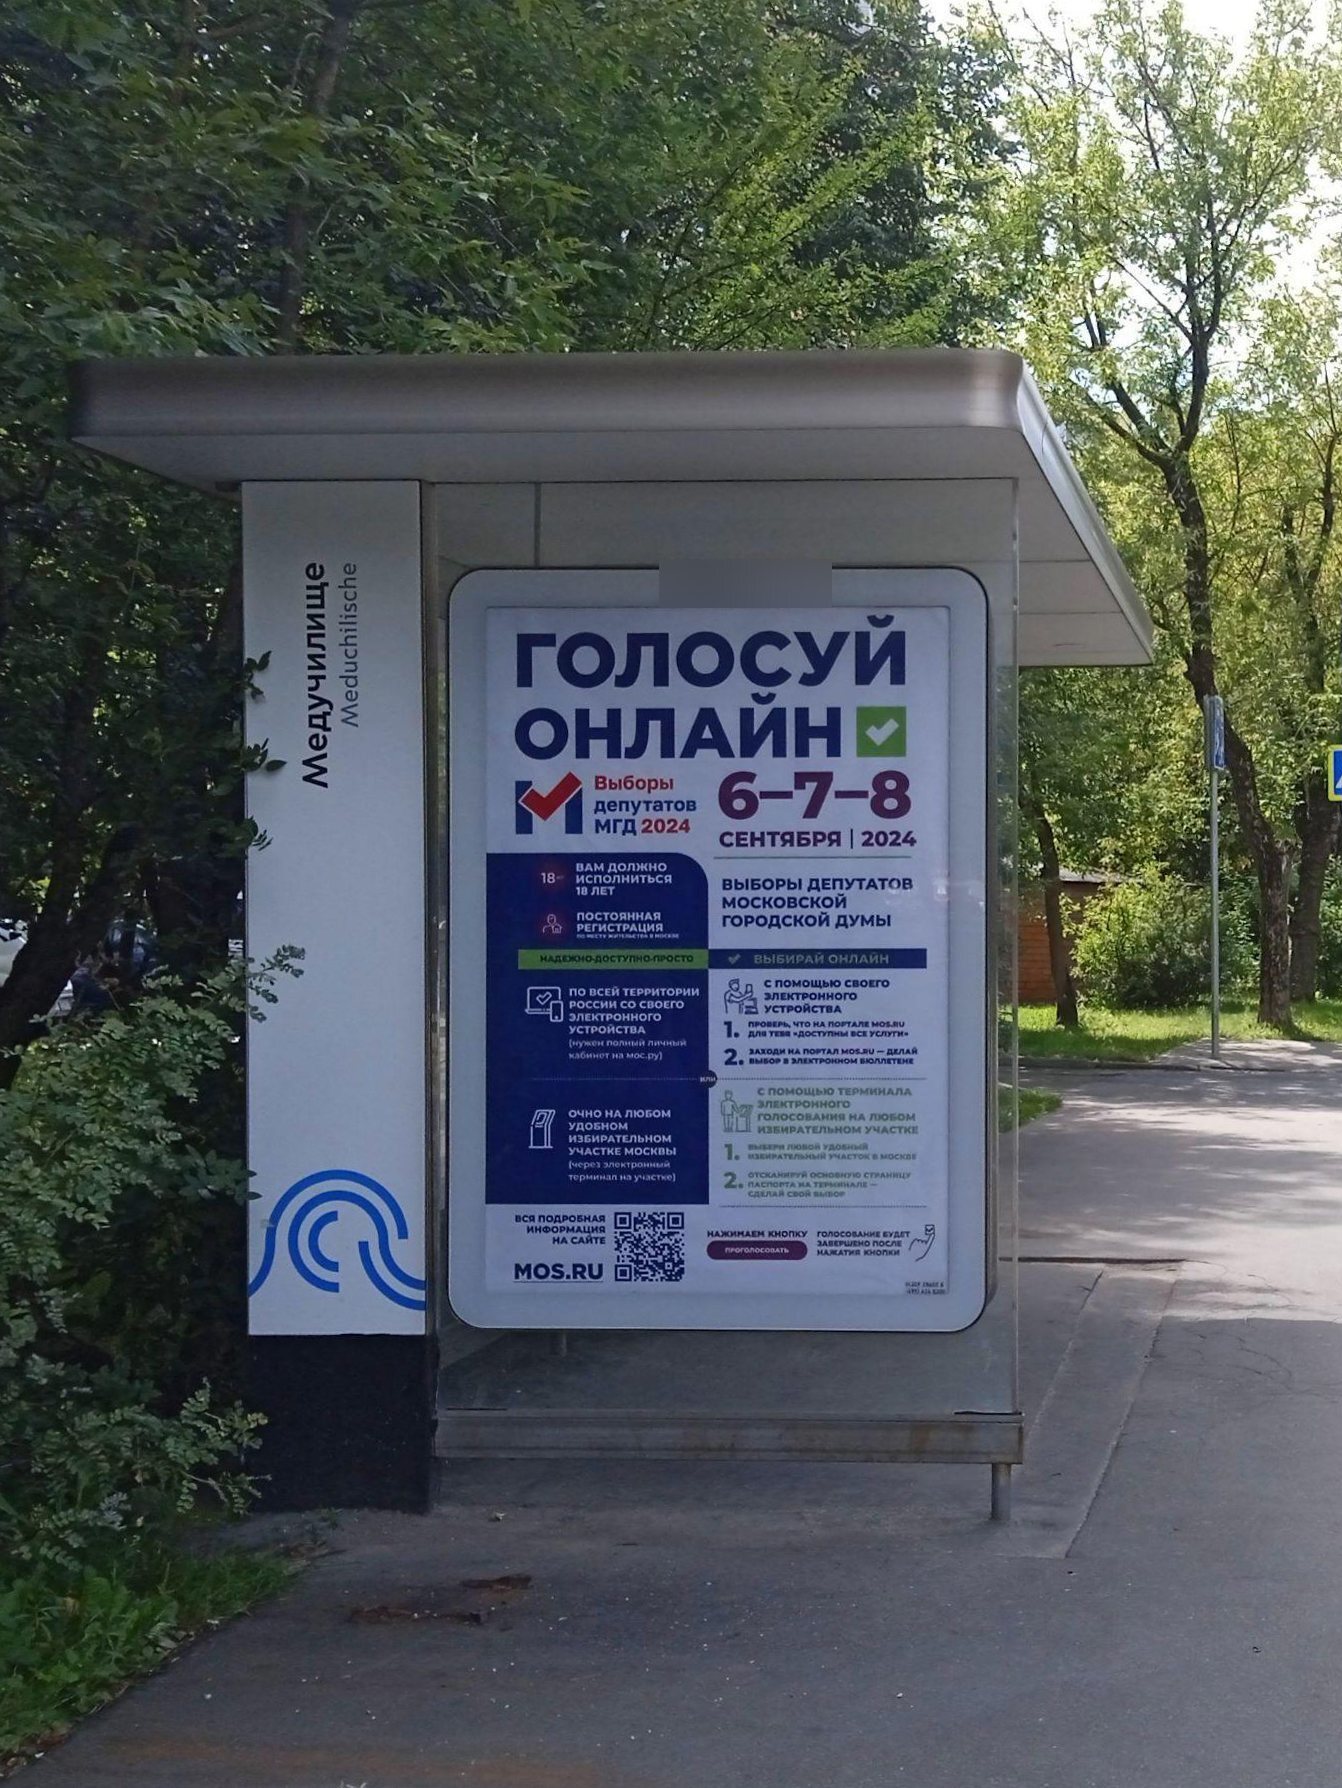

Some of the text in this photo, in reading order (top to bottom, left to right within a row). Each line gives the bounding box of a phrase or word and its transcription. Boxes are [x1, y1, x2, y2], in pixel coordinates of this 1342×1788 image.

[338, 562, 359, 728] Meduchilische
[515, 615, 907, 688] ГОЛОСУЙ
[302, 562, 334, 789] Медучилище
[514, 692, 842, 760] ОНЛАЙН
[594, 775, 674, 794] Выборы
[717, 770, 911, 820] 6–7–8
[593, 798, 697, 817] депутатов
[594, 818, 691, 837] МГД 2024
[719, 830, 917, 848] СЕНТЯБРЯ 2024
[576, 863, 667, 873] ВАМ ДОЛЖНО
[576, 874, 672, 884] ИСПОЛНИТЬСЯ
[722, 878, 913, 892] ВЫБОРЫ ДЕПУТАТОВ
[576, 887, 615, 896] 18 ЛЕТ
[722, 894, 847, 909] МОСКОВСКОЙ
[577, 912, 661, 921] ПОСТОЯННАЯ
[722, 912, 891, 929] ГОРОДСКОЙ ДУМЫ
[577, 923, 663, 934] РЕГИСТРАЦИЯ
[754, 953, 889, 964] ВЫБИРАЙ ОНЛАЙН
[764, 980, 890, 989] С ПОМОЩЬЮ СВОЕГО
[570, 985, 699, 997] ПО ВСЕЙ ТЕРРИТОРИИ
[764, 992, 857, 1001] ЭЛЕКТРОННОГО
[570, 1000, 685, 1009] РОССИИ СО СВОЕГО
[764, 1003, 842, 1014] УСТРОЙСТВА
[569, 1013, 661, 1022] ЭЛЕКТРОННОГО
[569, 1024, 646, 1034] УСТРОЙСТВА
[724, 1022, 740, 1038] 1.
[569, 1038, 687, 1048] (нужен полный личный
[886, 1047, 918, 1055] ДЕЛАЙ
[724, 1048, 744, 1065] 2.
[758, 1088, 912, 1097] С ПОМОЩЬЮ ТЕРМИНАЛА
[758, 1100, 850, 1109] ЭЛЕКТРОННОГО
[568, 1110, 671, 1119] ОЧНО НА ЛЮБОМ
[758, 1113, 916, 1121] ГОЛОСОВАНИЯ НА ЛЮБОМ
[568, 1122, 628, 1132] УДОБНОМ
[758, 1126, 919, 1134] ИЗБИРАТЕЛЬНОМ УЧАСТКЕ
[569, 1135, 672, 1144] ИЗБИРАТЕЛЬНОМ
[568, 1147, 677, 1156] УЧАСТКЕ МОСКВЫ
[724, 1144, 740, 1160] 1.
[569, 1160, 671, 1170] (через электронный
[569, 1174, 617, 1182] терминал
[634, 1173, 676, 1183] участке)
[724, 1172, 743, 1188] 2.
[515, 1215, 606, 1224] ВСЯ ПОДРОБНАЯ
[527, 1225, 606, 1235] ИНФОРМАЦИЯ
[883, 1231, 910, 1239] БУДЕТ
[552, 1234, 606, 1244] НА САЙТЕ
[514, 1263, 604, 1279] MOS.RU
